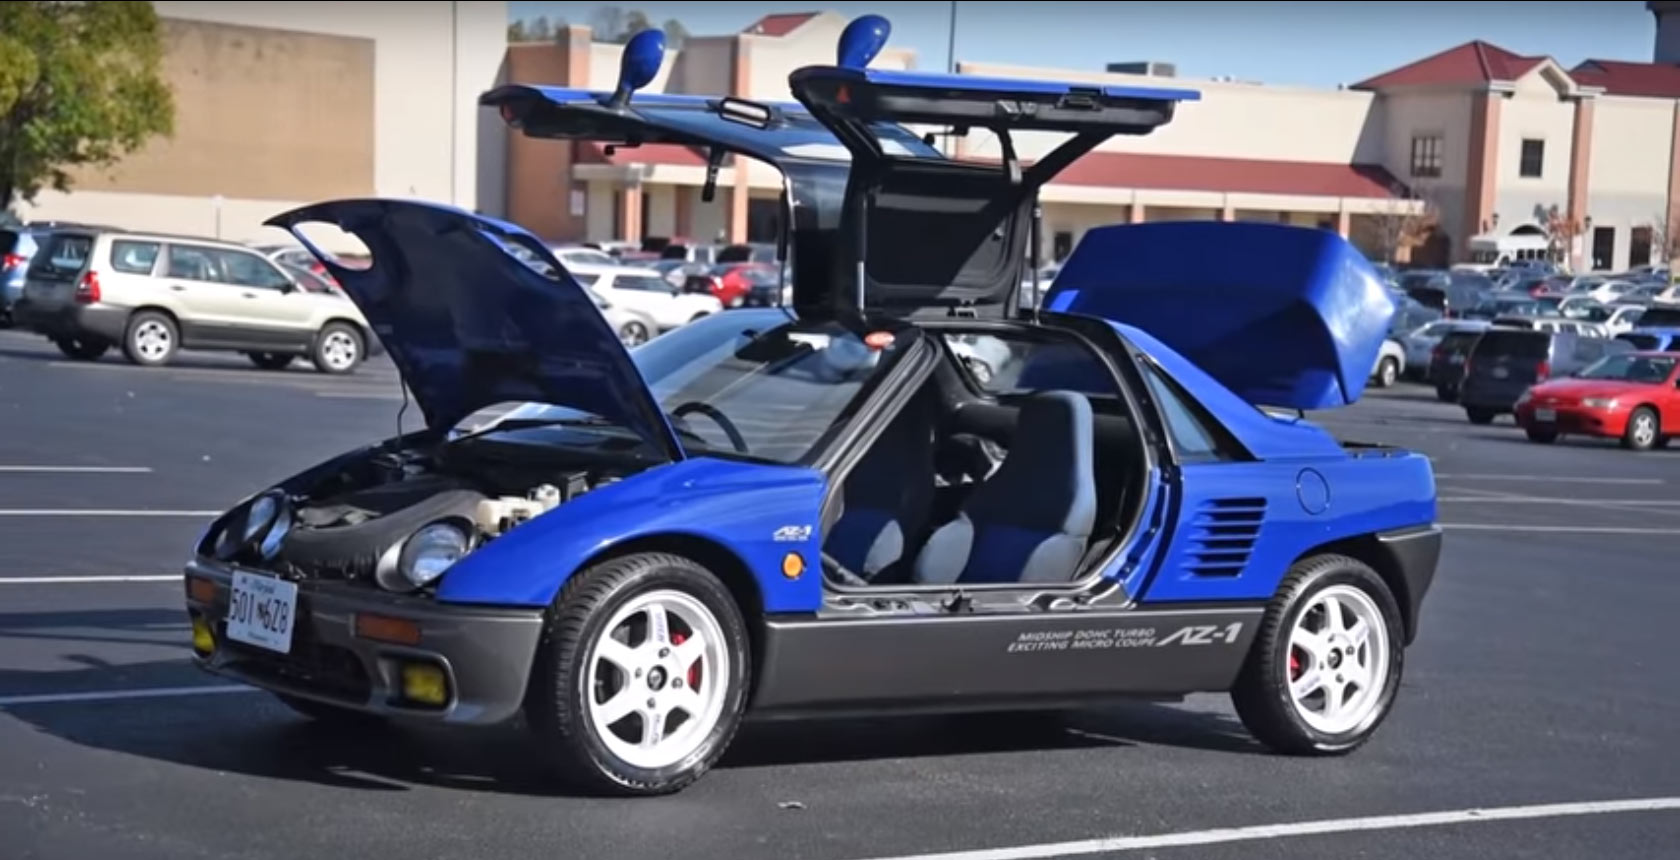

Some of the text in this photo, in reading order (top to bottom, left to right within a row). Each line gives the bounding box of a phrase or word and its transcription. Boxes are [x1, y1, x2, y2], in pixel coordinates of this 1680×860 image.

[230, 587, 255, 625] 501
[1018, 627, 1156, 641] MIDSHIP DOHC TURBO
[1156, 622, 1244, 647] AZ-1
[1007, 637, 1157, 652] EXCITING MICRO COUPE
